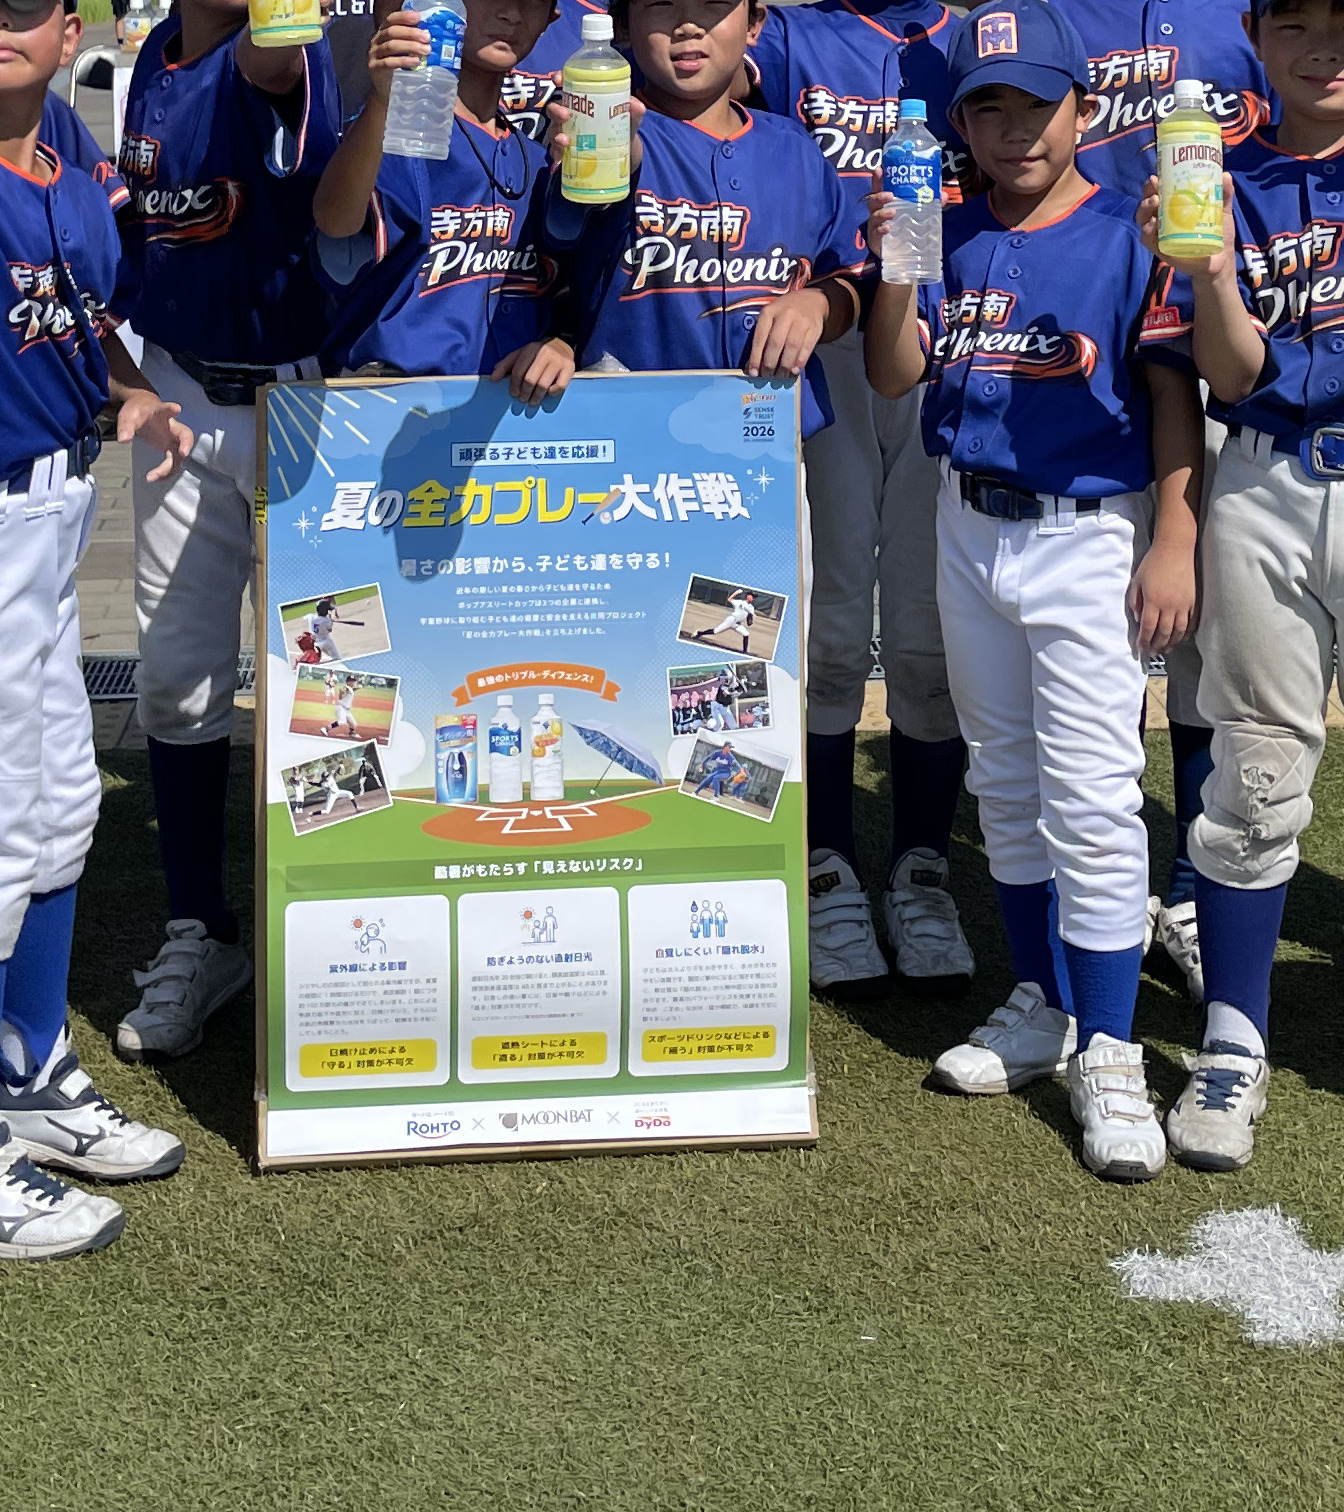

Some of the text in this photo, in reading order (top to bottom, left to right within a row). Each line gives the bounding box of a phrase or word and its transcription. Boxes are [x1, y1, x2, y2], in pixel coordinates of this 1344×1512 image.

[803, 89, 899, 134] 寺方南
[885, 165, 933, 178] SPORTS
[430, 207, 511, 240] 寺方南
[635, 194, 744, 243] 寺方南
[743, 426, 775, 437] 2026
[458, 445, 607, 463] 頑張る子ども達を応援！
[320, 472, 751, 532] 夏の全力プレー大作戦
[400, 552, 670, 576] 暑さの影響から、子ども達を守る！
[434, 858, 643, 879] 酷暑がもたらす「見えないリスク」
[329, 960, 408, 974] 紫外線による影響
[486, 952, 593, 966] 防ぎようのない直射日光
[648, 1030, 770, 1043] スポーツドリンクなどによる
[329, 1045, 407, 1057] 日焼け止めによる
[521, 1109, 594, 1125] MOONBAT
[634, 1118, 672, 1129] DyDo
[407, 1119, 461, 1136] ROHTO
